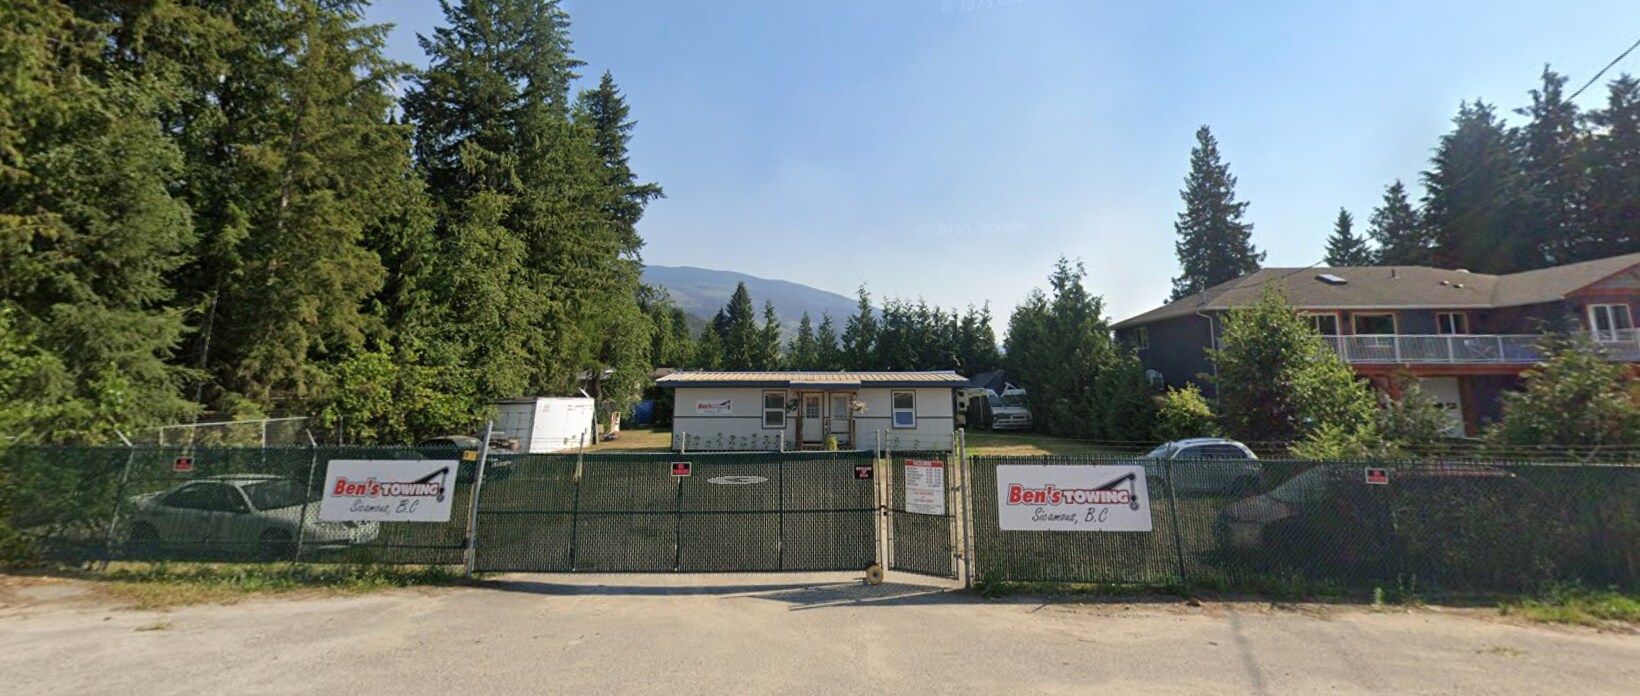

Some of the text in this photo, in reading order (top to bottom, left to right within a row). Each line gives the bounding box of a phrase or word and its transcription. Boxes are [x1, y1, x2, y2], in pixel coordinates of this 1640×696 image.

[332, 477, 440, 497] Ben's TOWING
[1007, 484, 1130, 505] Ben's TOWING
[1032, 507, 1078, 524] Sicamous,
